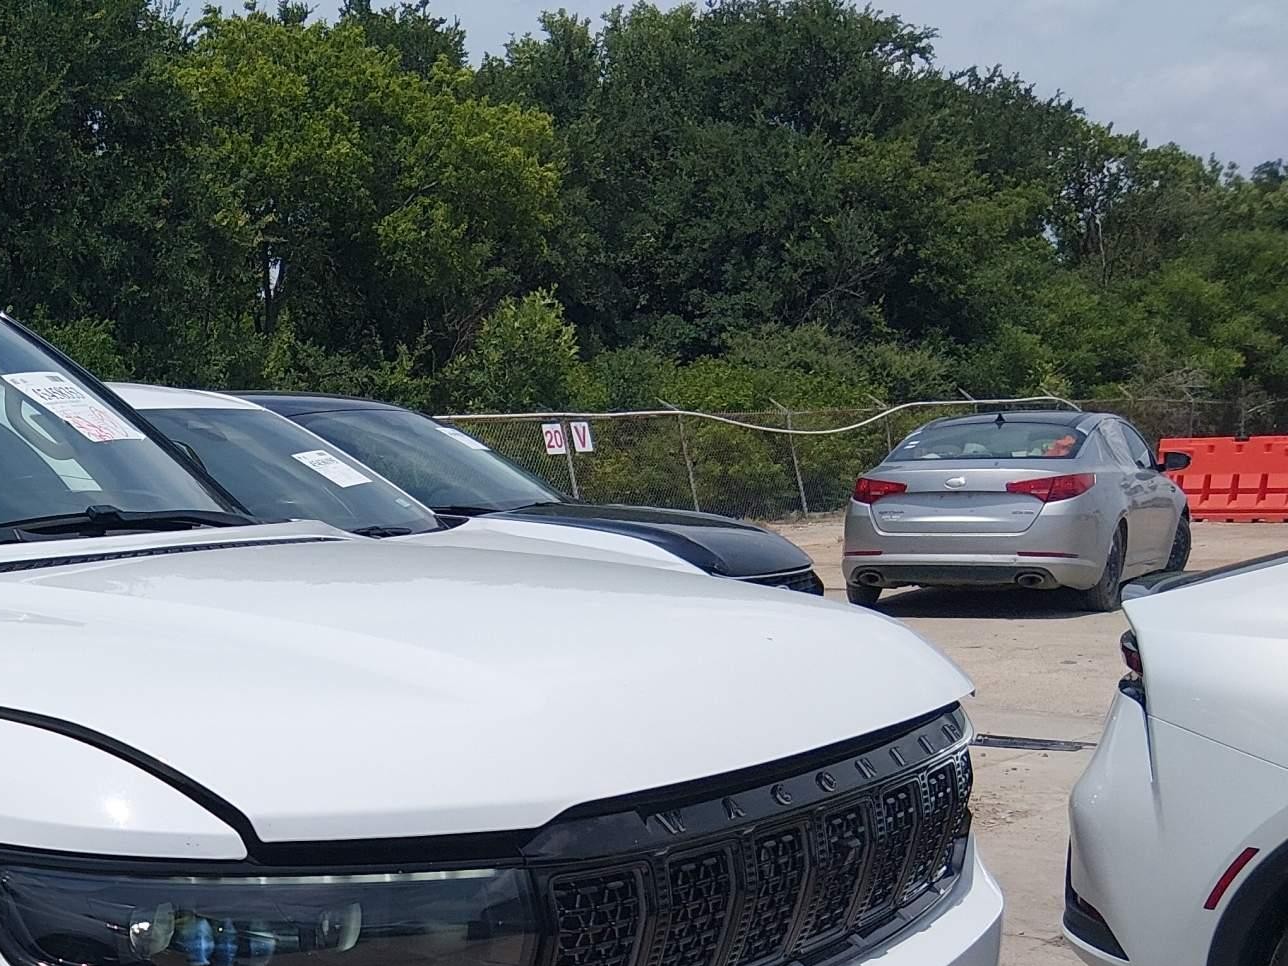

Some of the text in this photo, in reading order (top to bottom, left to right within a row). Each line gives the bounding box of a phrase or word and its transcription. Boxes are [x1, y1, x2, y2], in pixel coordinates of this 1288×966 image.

[545, 430, 563, 448] 20
[574, 425, 586, 448] V
[654, 723, 961, 834] WAGONEER
